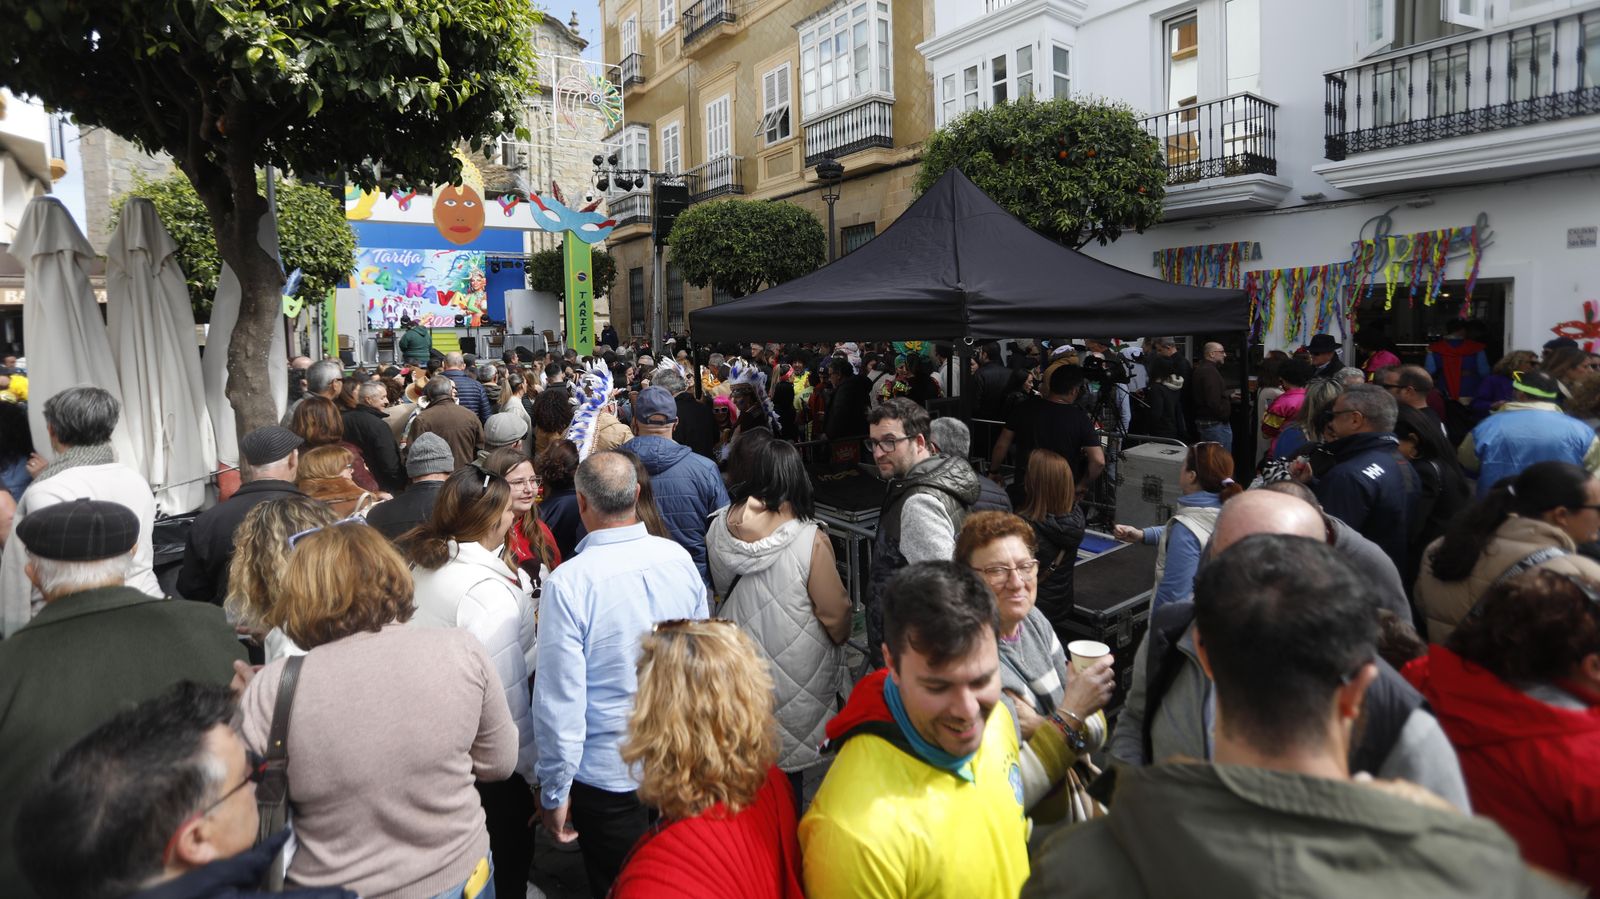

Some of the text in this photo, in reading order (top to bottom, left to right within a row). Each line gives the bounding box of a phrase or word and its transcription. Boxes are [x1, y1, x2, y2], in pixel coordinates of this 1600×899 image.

[372, 249, 423, 266] Tarifa
[360, 266, 481, 314] CARNAVAL
[424, 315, 456, 328] 202
[578, 291, 588, 344] TARIFA
